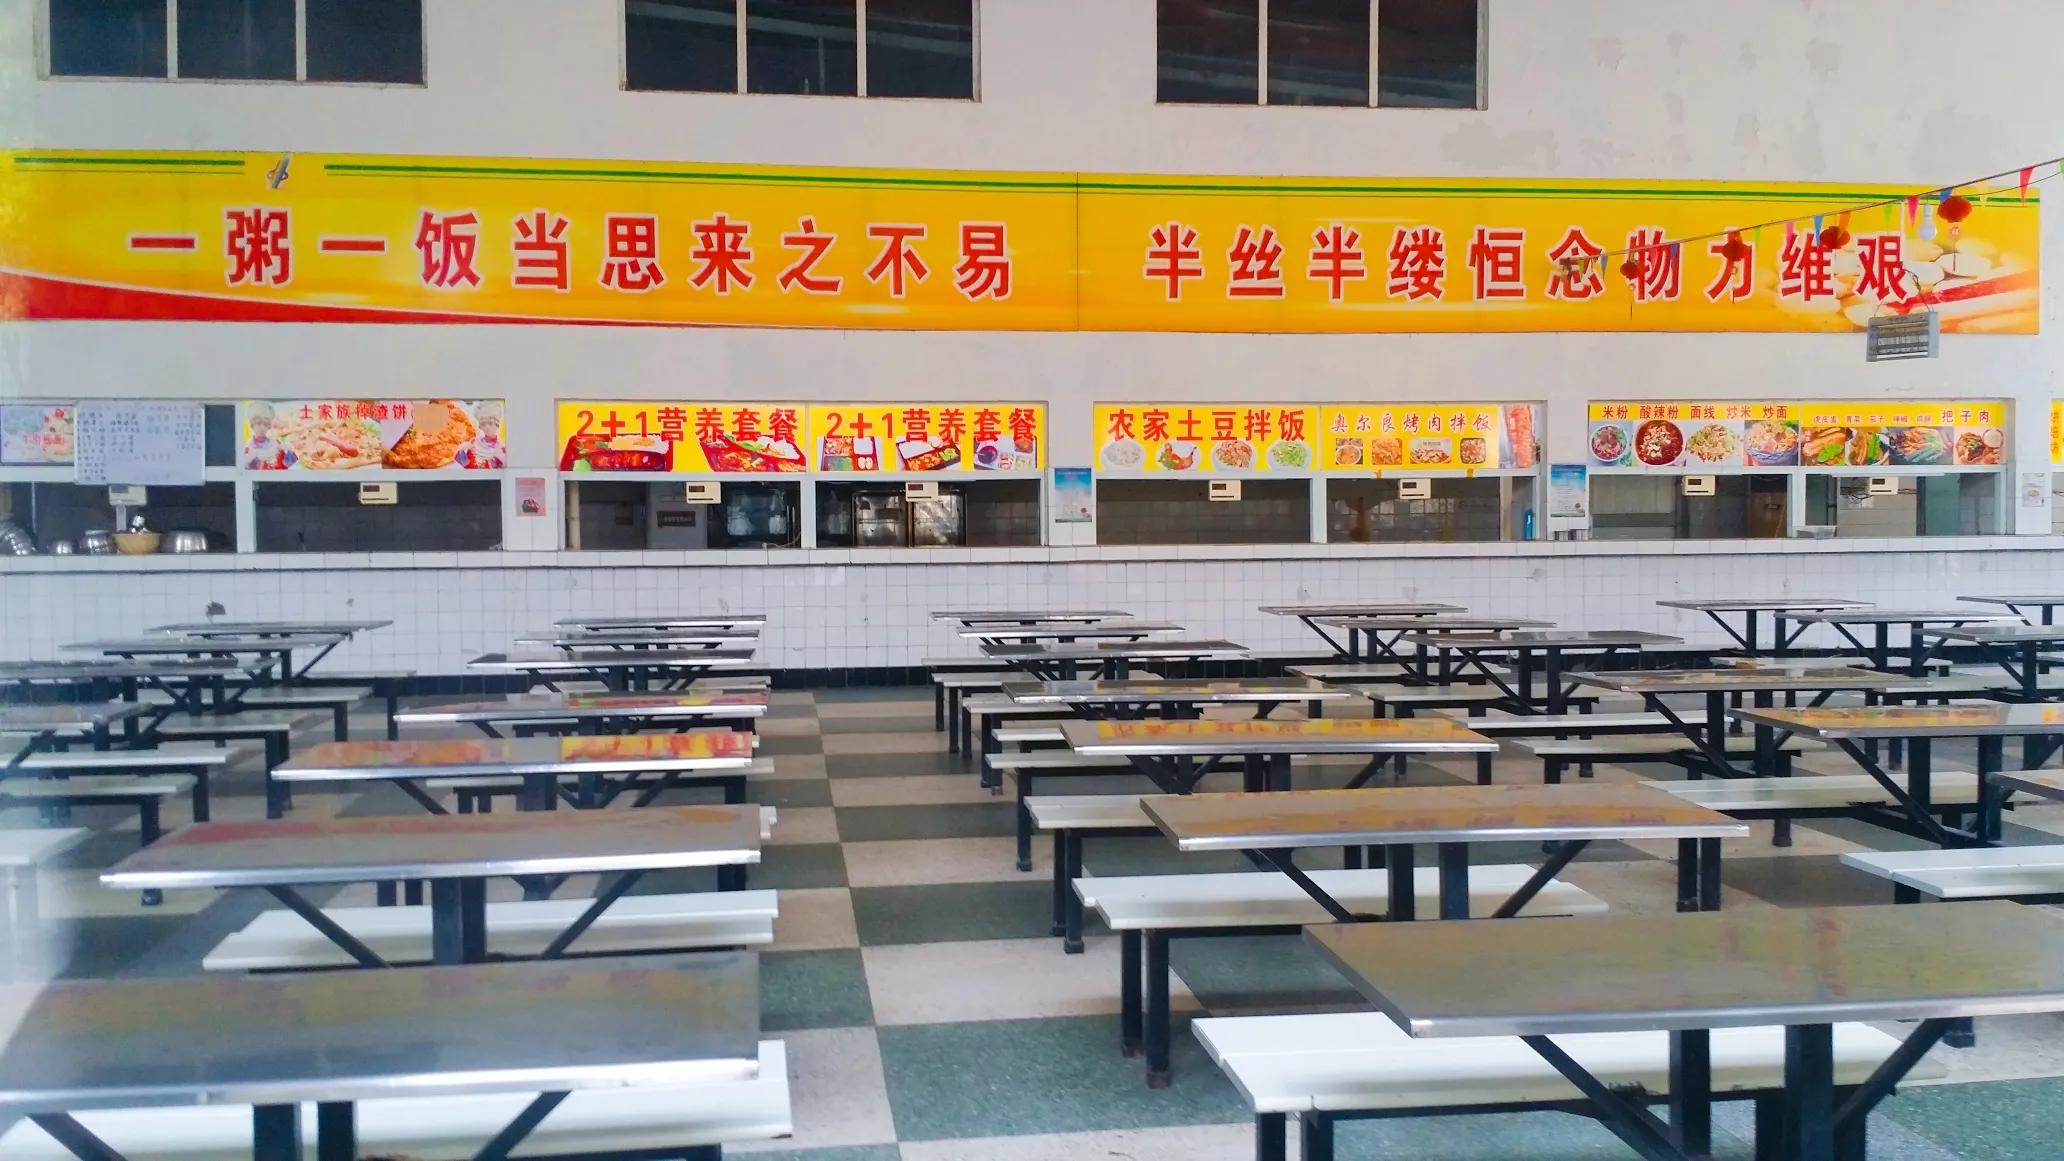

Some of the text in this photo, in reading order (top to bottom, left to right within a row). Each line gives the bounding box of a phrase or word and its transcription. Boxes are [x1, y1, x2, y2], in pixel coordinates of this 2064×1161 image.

[130, 208, 1908, 301] 一粥一饭当思来之不易 半丝半缕恒念物力维艰
[576, 407, 798, 442] 2+1营养套餐
[826, 408, 1036, 442] 2+1营养套餐
[1108, 408, 1305, 442] 农家土豆拌饭
[1330, 412, 1492, 433] 奥尔良烤肉拌饭
[1603, 405, 1788, 419] 米粉 酸辣粉 面线 炒米 炒面
[1941, 410, 1990, 423] 把子肉
